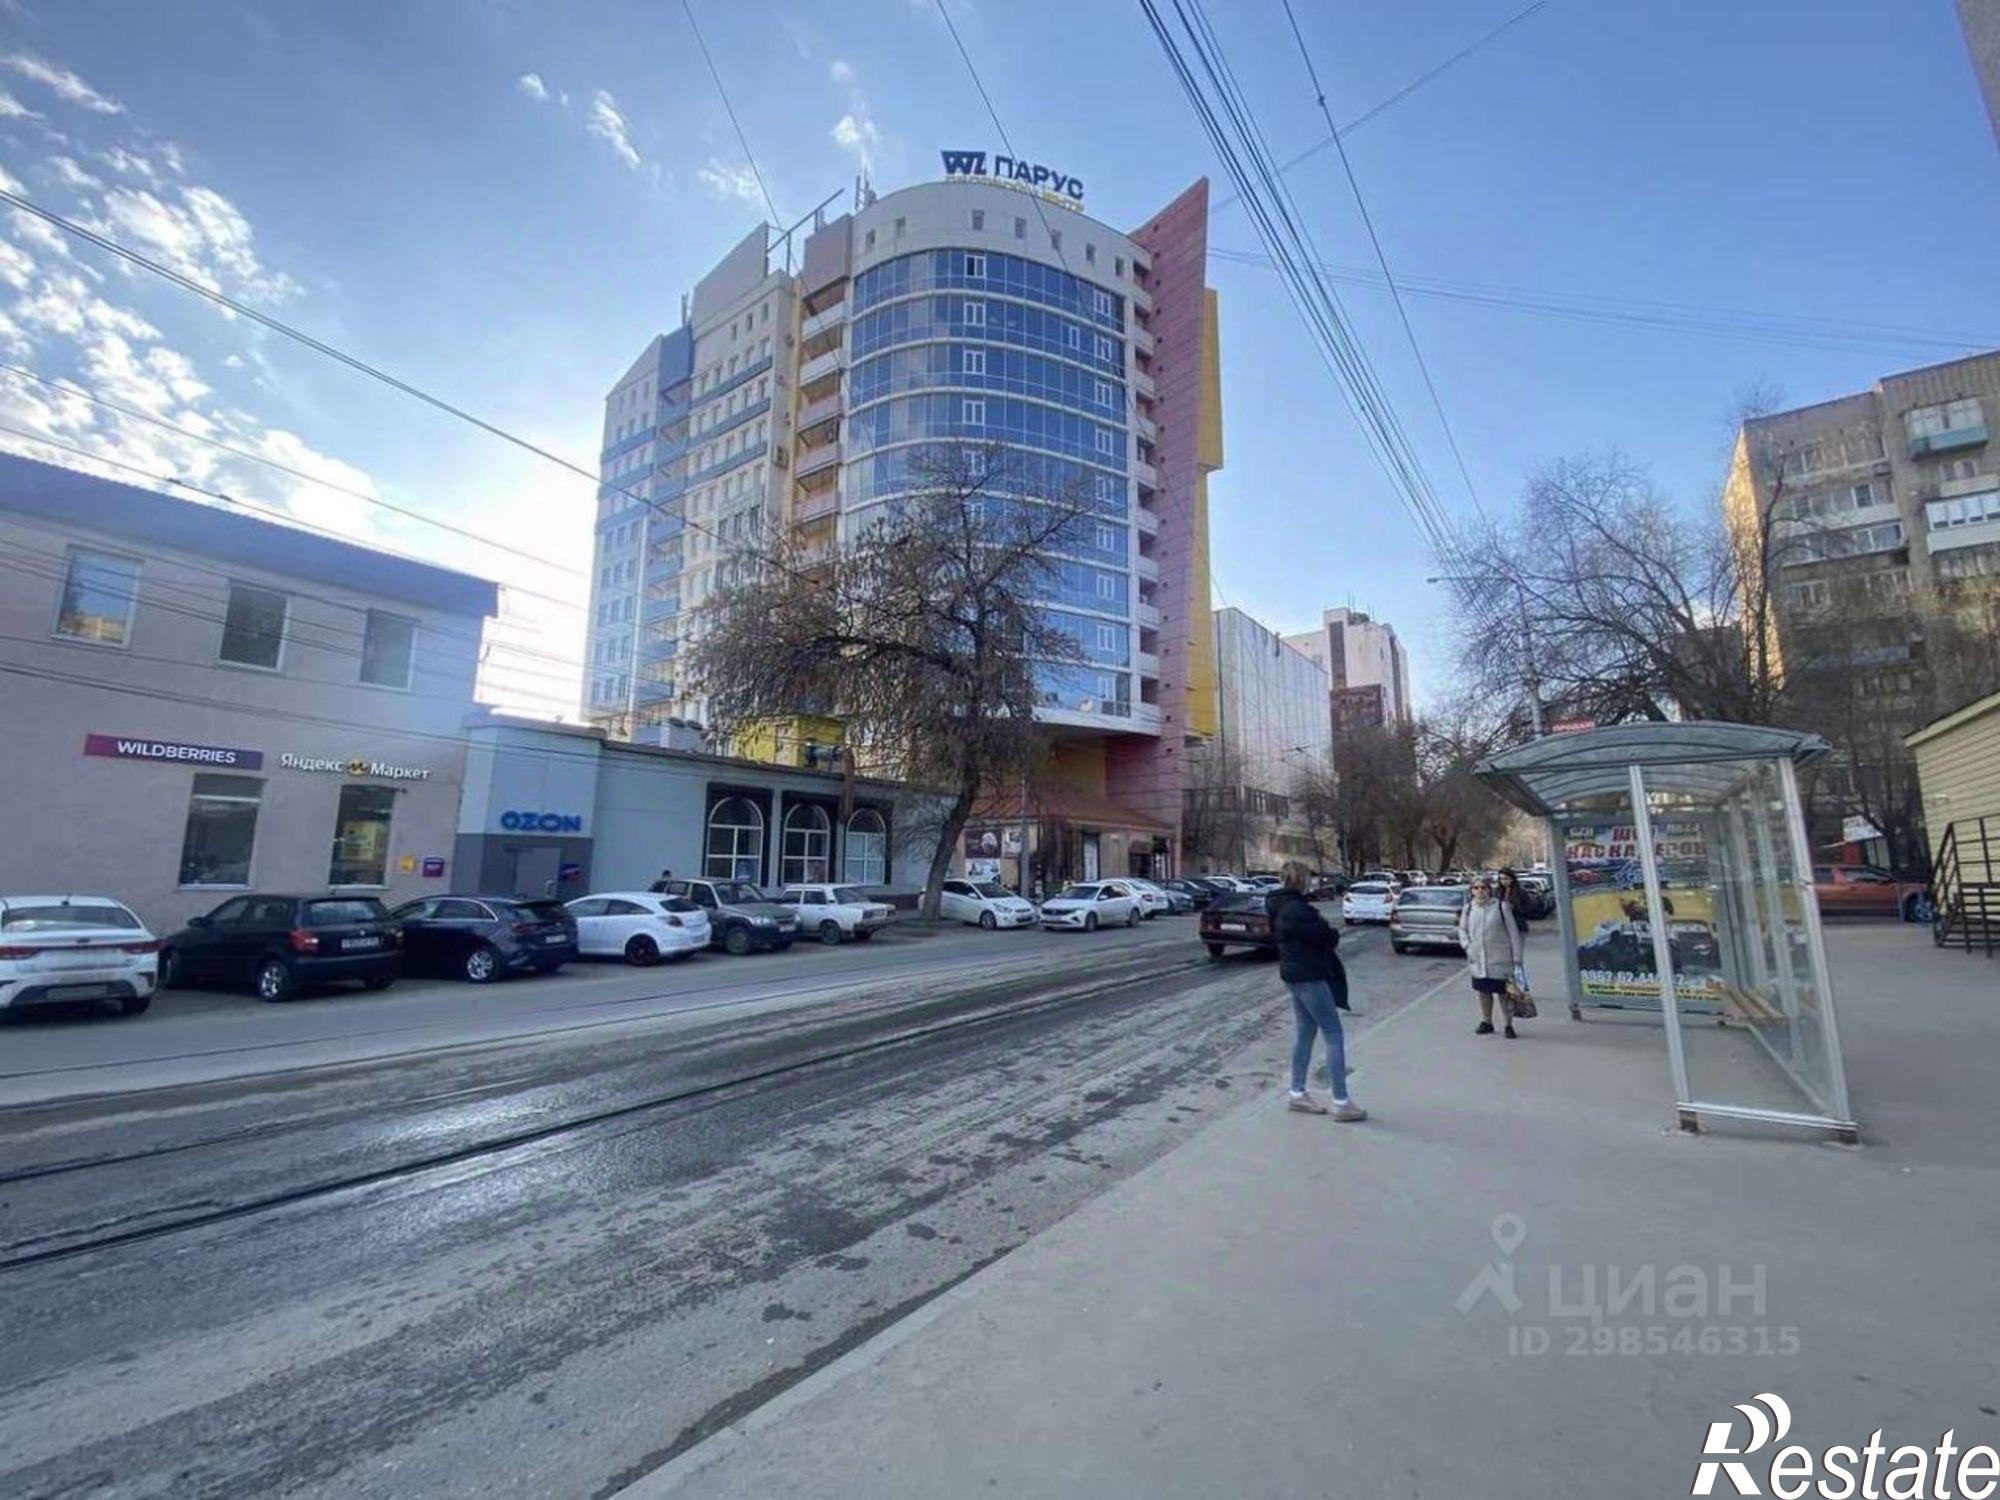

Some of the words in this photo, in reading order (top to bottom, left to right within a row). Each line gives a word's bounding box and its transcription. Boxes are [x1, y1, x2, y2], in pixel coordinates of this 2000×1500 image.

[995, 155, 1084, 200] ПАРУС
[117, 739, 236, 764] WILDBERRIES
[280, 750, 345, 774] Яндекс
[368, 760, 432, 782] Маркет
[501, 810, 583, 832] OZON
